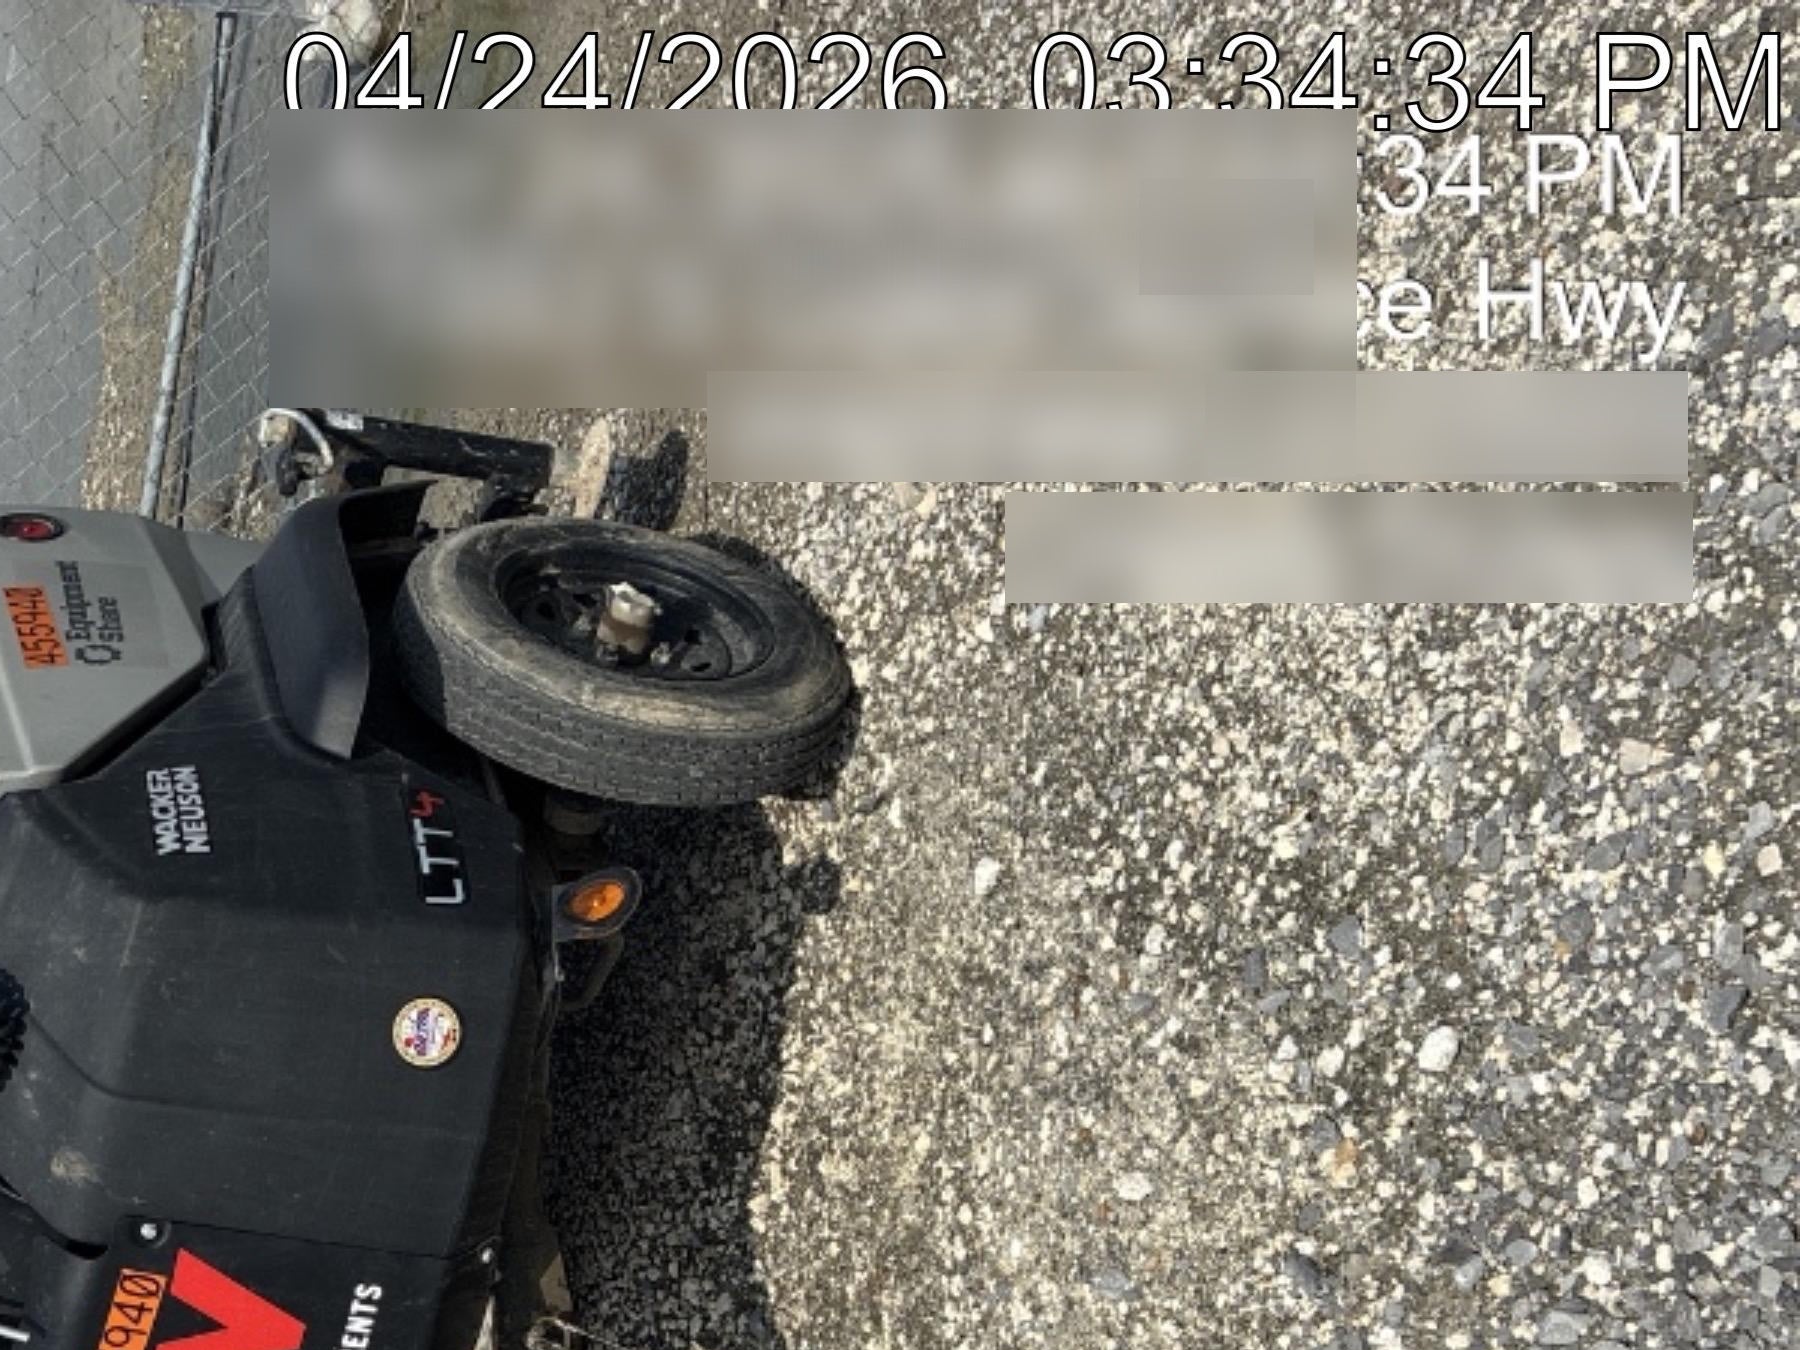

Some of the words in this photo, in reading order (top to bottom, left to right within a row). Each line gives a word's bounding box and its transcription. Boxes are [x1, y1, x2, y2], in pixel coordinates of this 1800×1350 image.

[4, 587, 62, 665] 455940
[54, 560, 96, 642] Equipment
[96, 596, 124, 643] Share
[146, 768, 181, 855] WACKER
[172, 765, 211, 853] NEUSON
